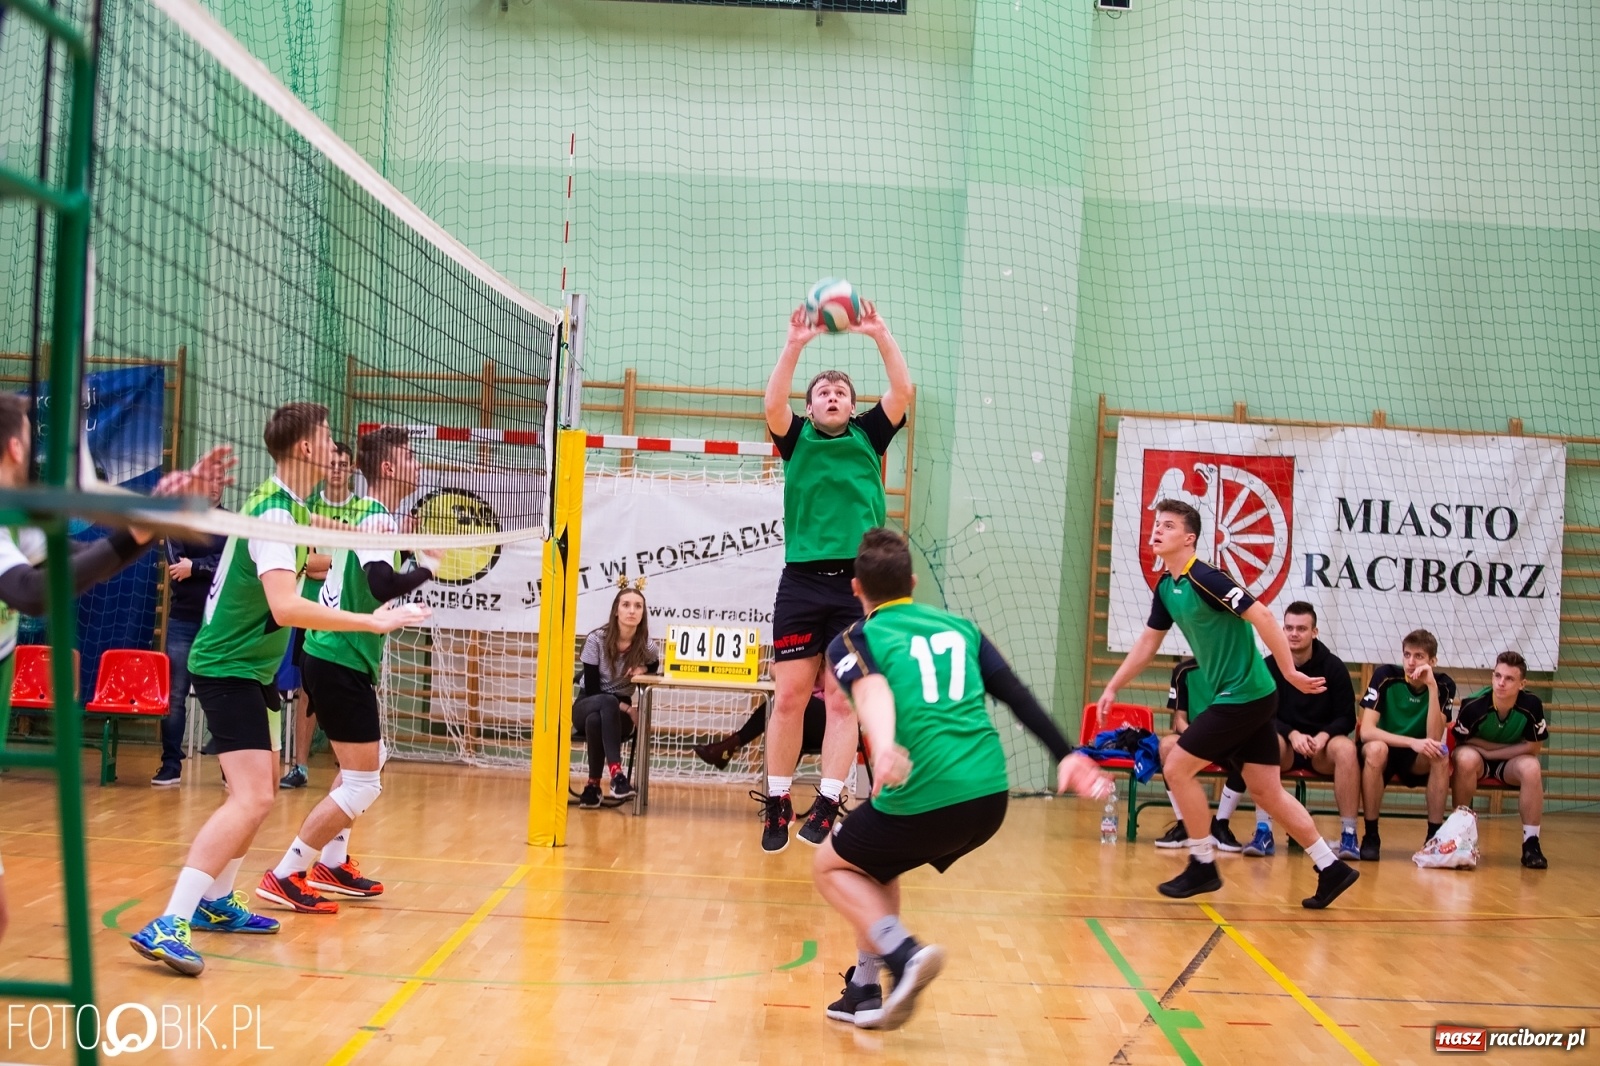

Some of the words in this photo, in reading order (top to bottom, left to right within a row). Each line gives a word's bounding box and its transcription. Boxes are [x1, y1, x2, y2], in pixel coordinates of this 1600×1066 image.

[1334, 497, 1519, 541] MIASTO
[636, 518, 784, 575] PORZĄDK
[1301, 551, 1546, 599] RACIBÓRZ
[910, 630, 966, 703] 17
